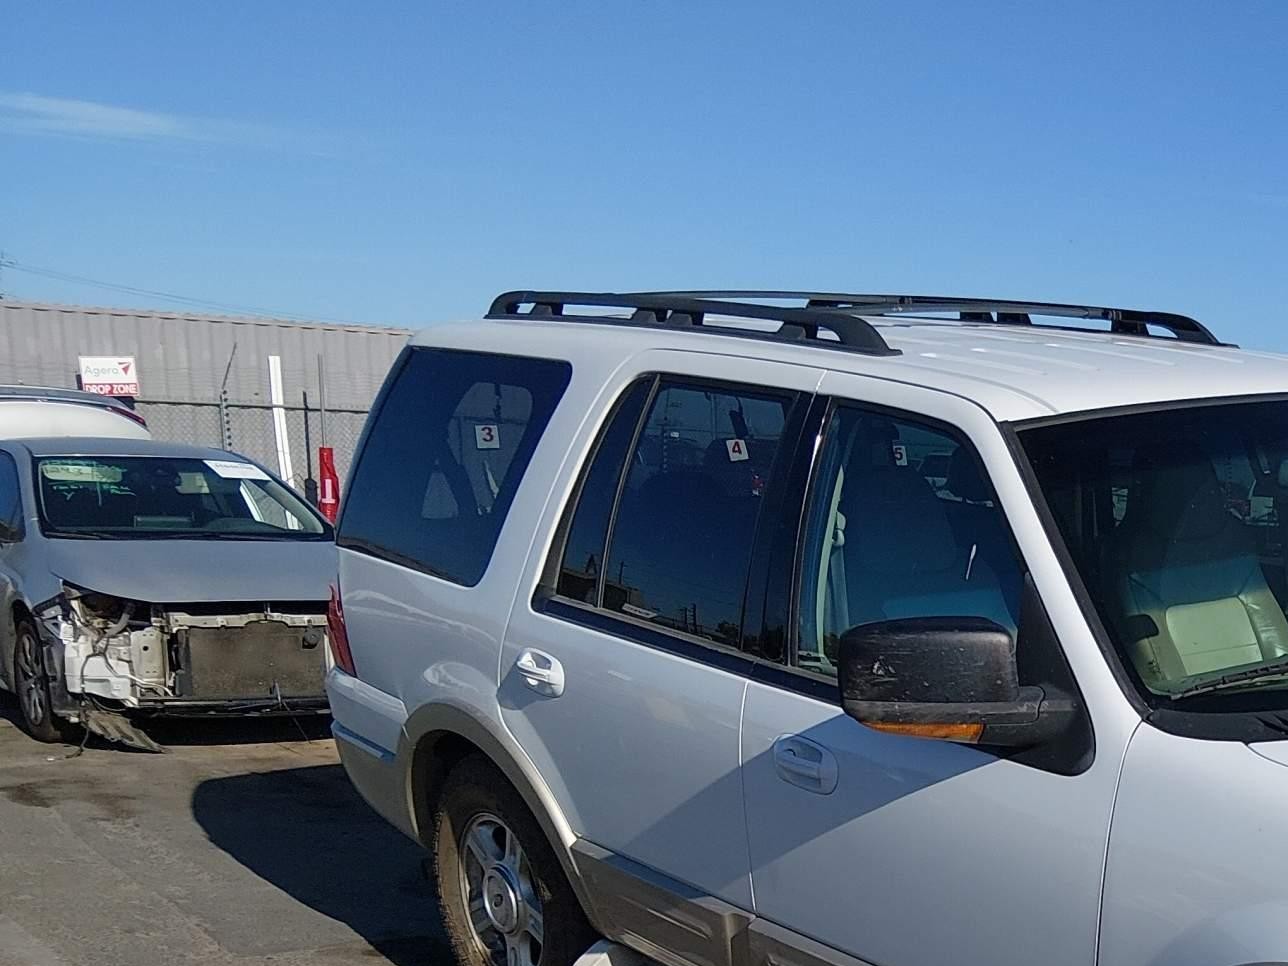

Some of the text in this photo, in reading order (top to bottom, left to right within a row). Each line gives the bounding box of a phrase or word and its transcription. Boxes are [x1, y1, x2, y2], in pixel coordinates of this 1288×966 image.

[85, 384, 137, 395] DROP ZONE
[481, 426, 494, 442] 3
[732, 441, 742, 455] 4
[895, 447, 903, 461] 5
